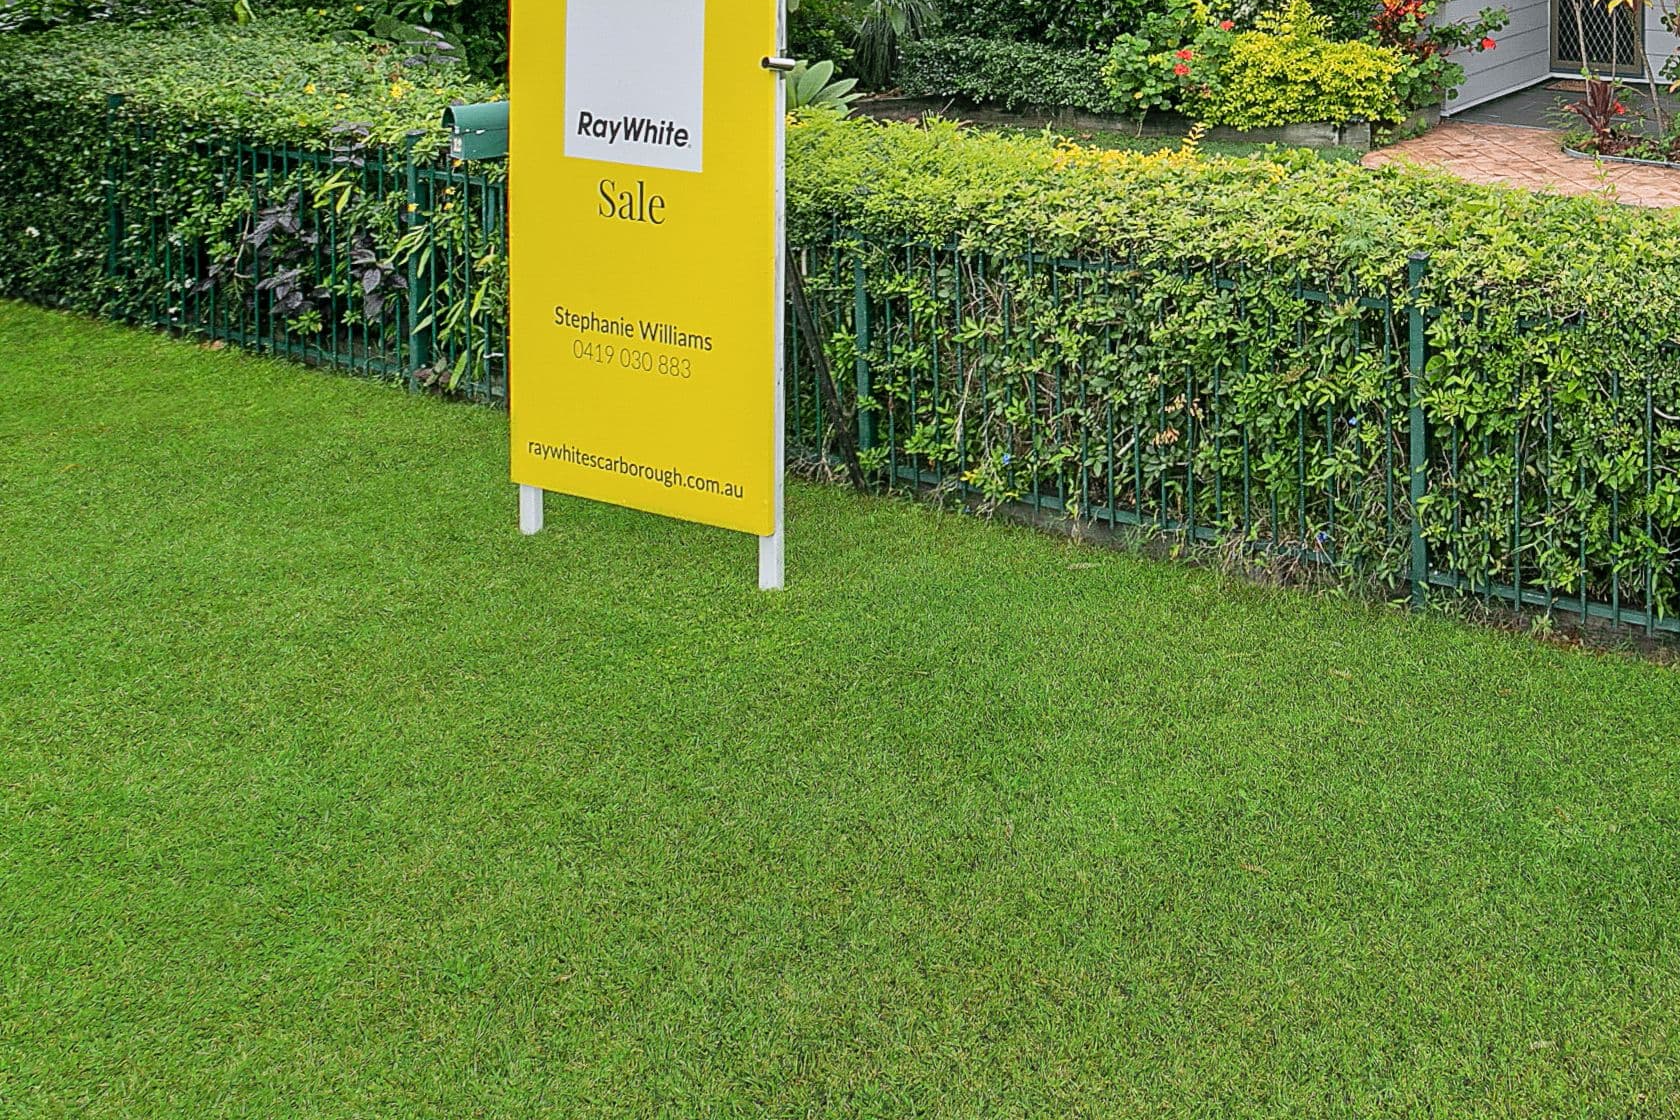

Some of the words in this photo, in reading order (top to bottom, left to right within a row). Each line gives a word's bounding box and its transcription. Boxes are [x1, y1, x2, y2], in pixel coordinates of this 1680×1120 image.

[599, 179, 666, 224] Sale
[554, 306, 634, 338] Stephanie
[639, 320, 713, 351] Williams
[573, 339, 614, 364] 0419
[619, 348, 653, 372] 030
[658, 355, 692, 379] 883
[528, 440, 744, 498] raywhitescarborough.com.au
